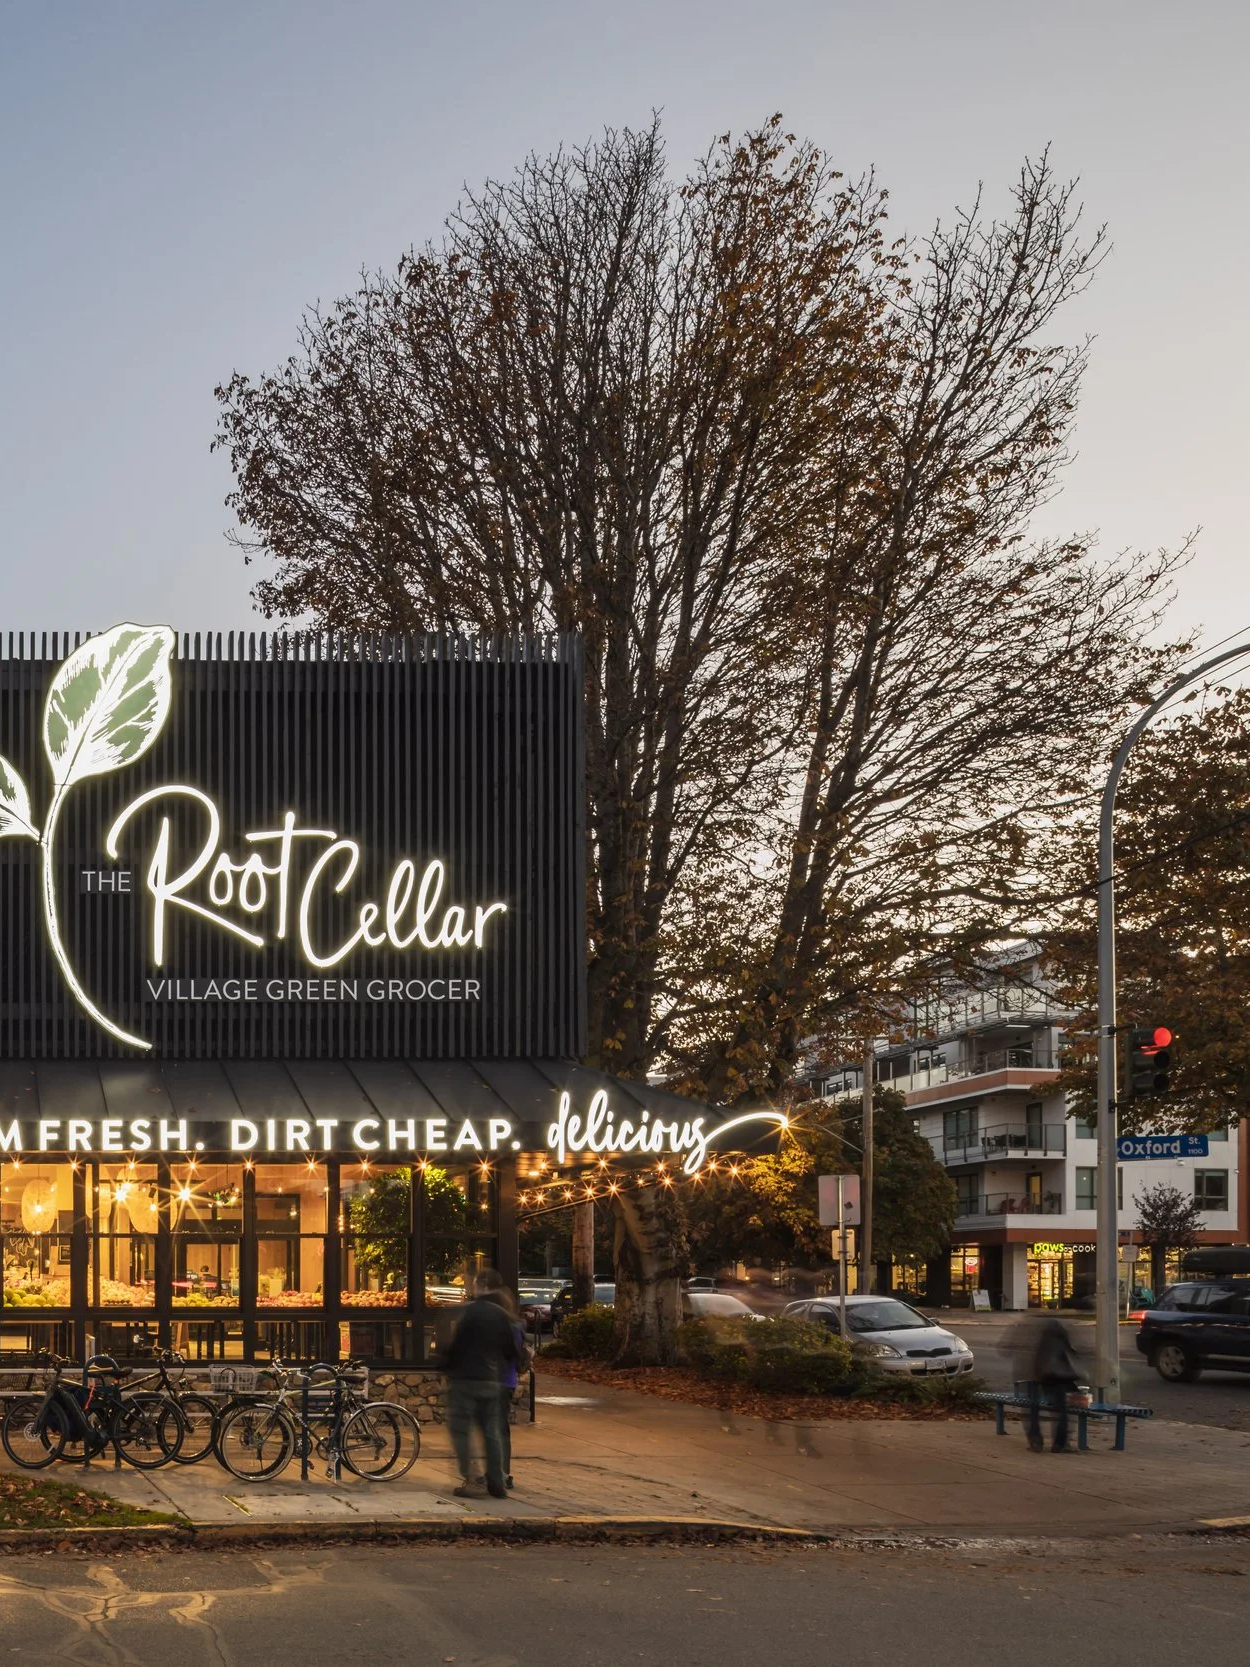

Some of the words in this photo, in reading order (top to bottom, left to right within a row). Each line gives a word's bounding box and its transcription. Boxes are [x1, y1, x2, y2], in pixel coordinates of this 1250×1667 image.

[82, 871, 131, 892] THE
[107, 785, 338, 967] Root
[300, 840, 508, 968] Cellar
[146, 979, 258, 1001] VILLAGE
[265, 979, 358, 1001] GREEN
[366, 979, 481, 1001] GROCER
[39, 1119, 205, 1151] FRESH.
[230, 1119, 338, 1151] DIRT
[352, 1119, 521, 1151] CHEAP.
[547, 1089, 789, 1175] delicious
[1121, 1140, 1181, 1155] Oxford
[1034, 1243, 1065, 1255] paws
[1072, 1243, 1097, 1253] cook
